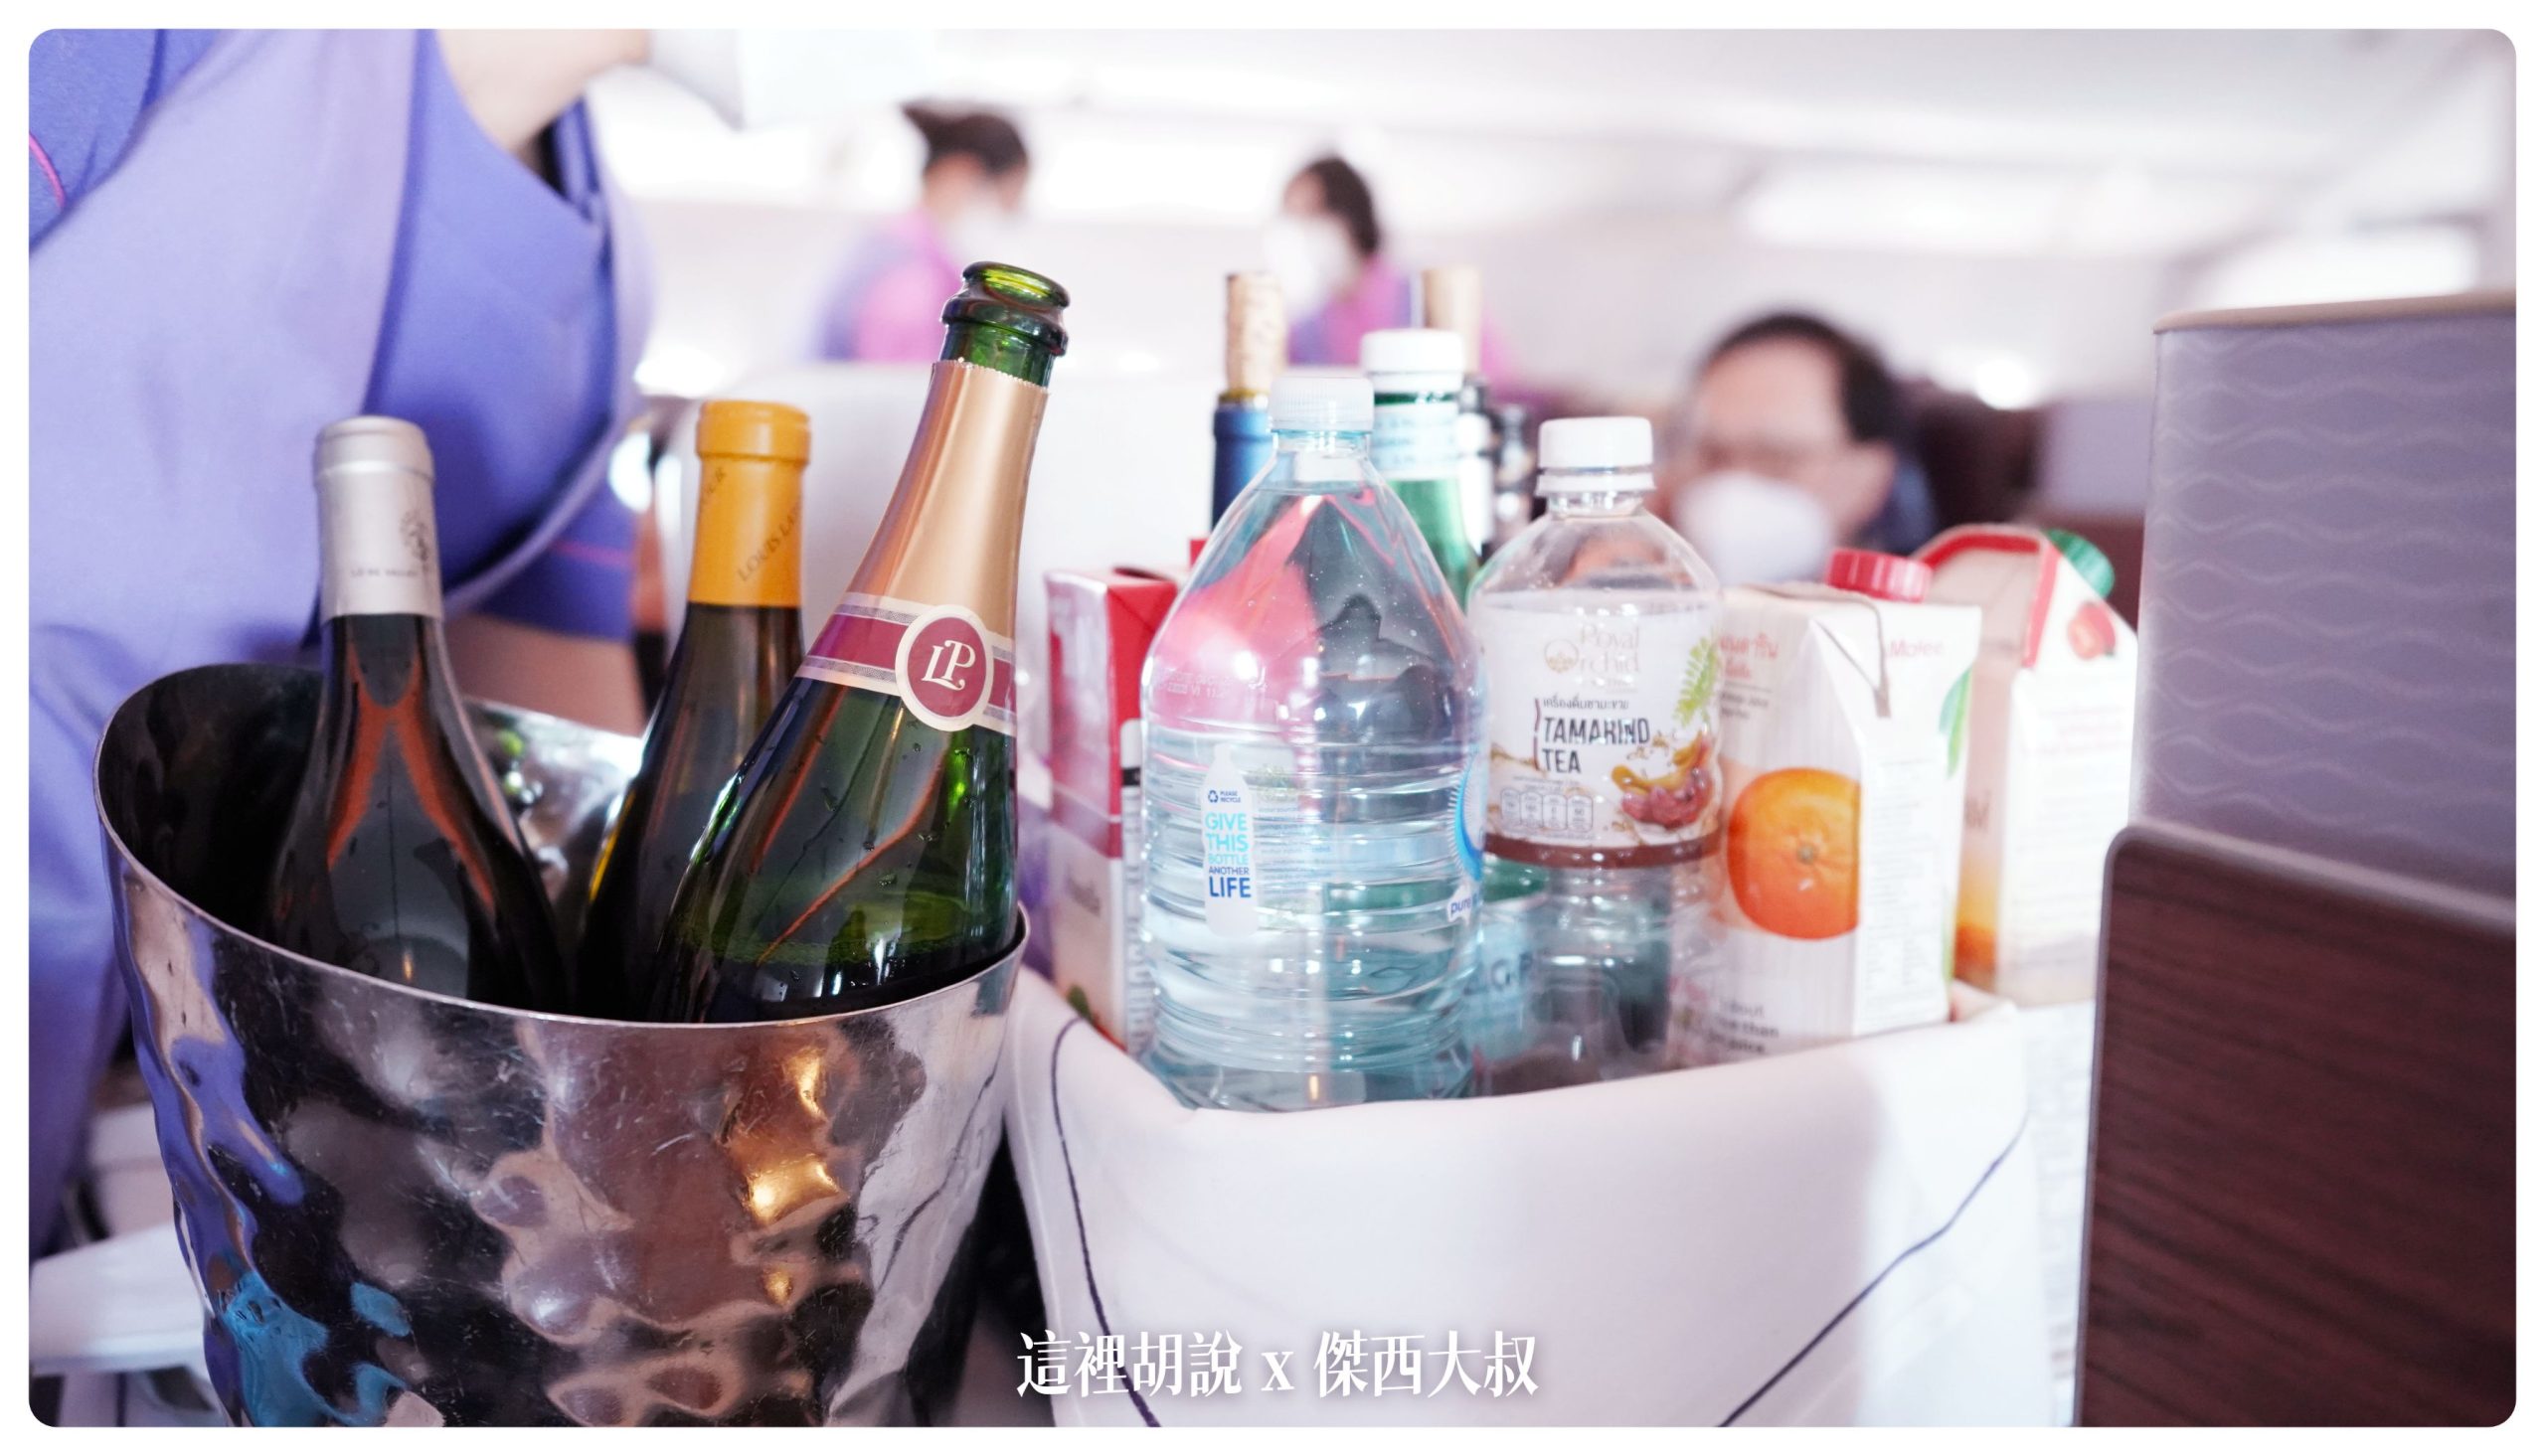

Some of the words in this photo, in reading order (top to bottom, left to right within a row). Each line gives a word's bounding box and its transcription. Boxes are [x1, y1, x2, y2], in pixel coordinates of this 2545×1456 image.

[738, 534, 780, 581] LOUIS
[1544, 717, 1651, 745] TAMARIND
[1542, 748, 1582, 774] TEA
[1205, 812, 1249, 832] GIVE
[1205, 832, 1250, 853] THIS
[1208, 854, 1249, 866] BOTTLE
[1208, 866, 1250, 876] ANOTHER
[1209, 876, 1252, 898] LIFE
